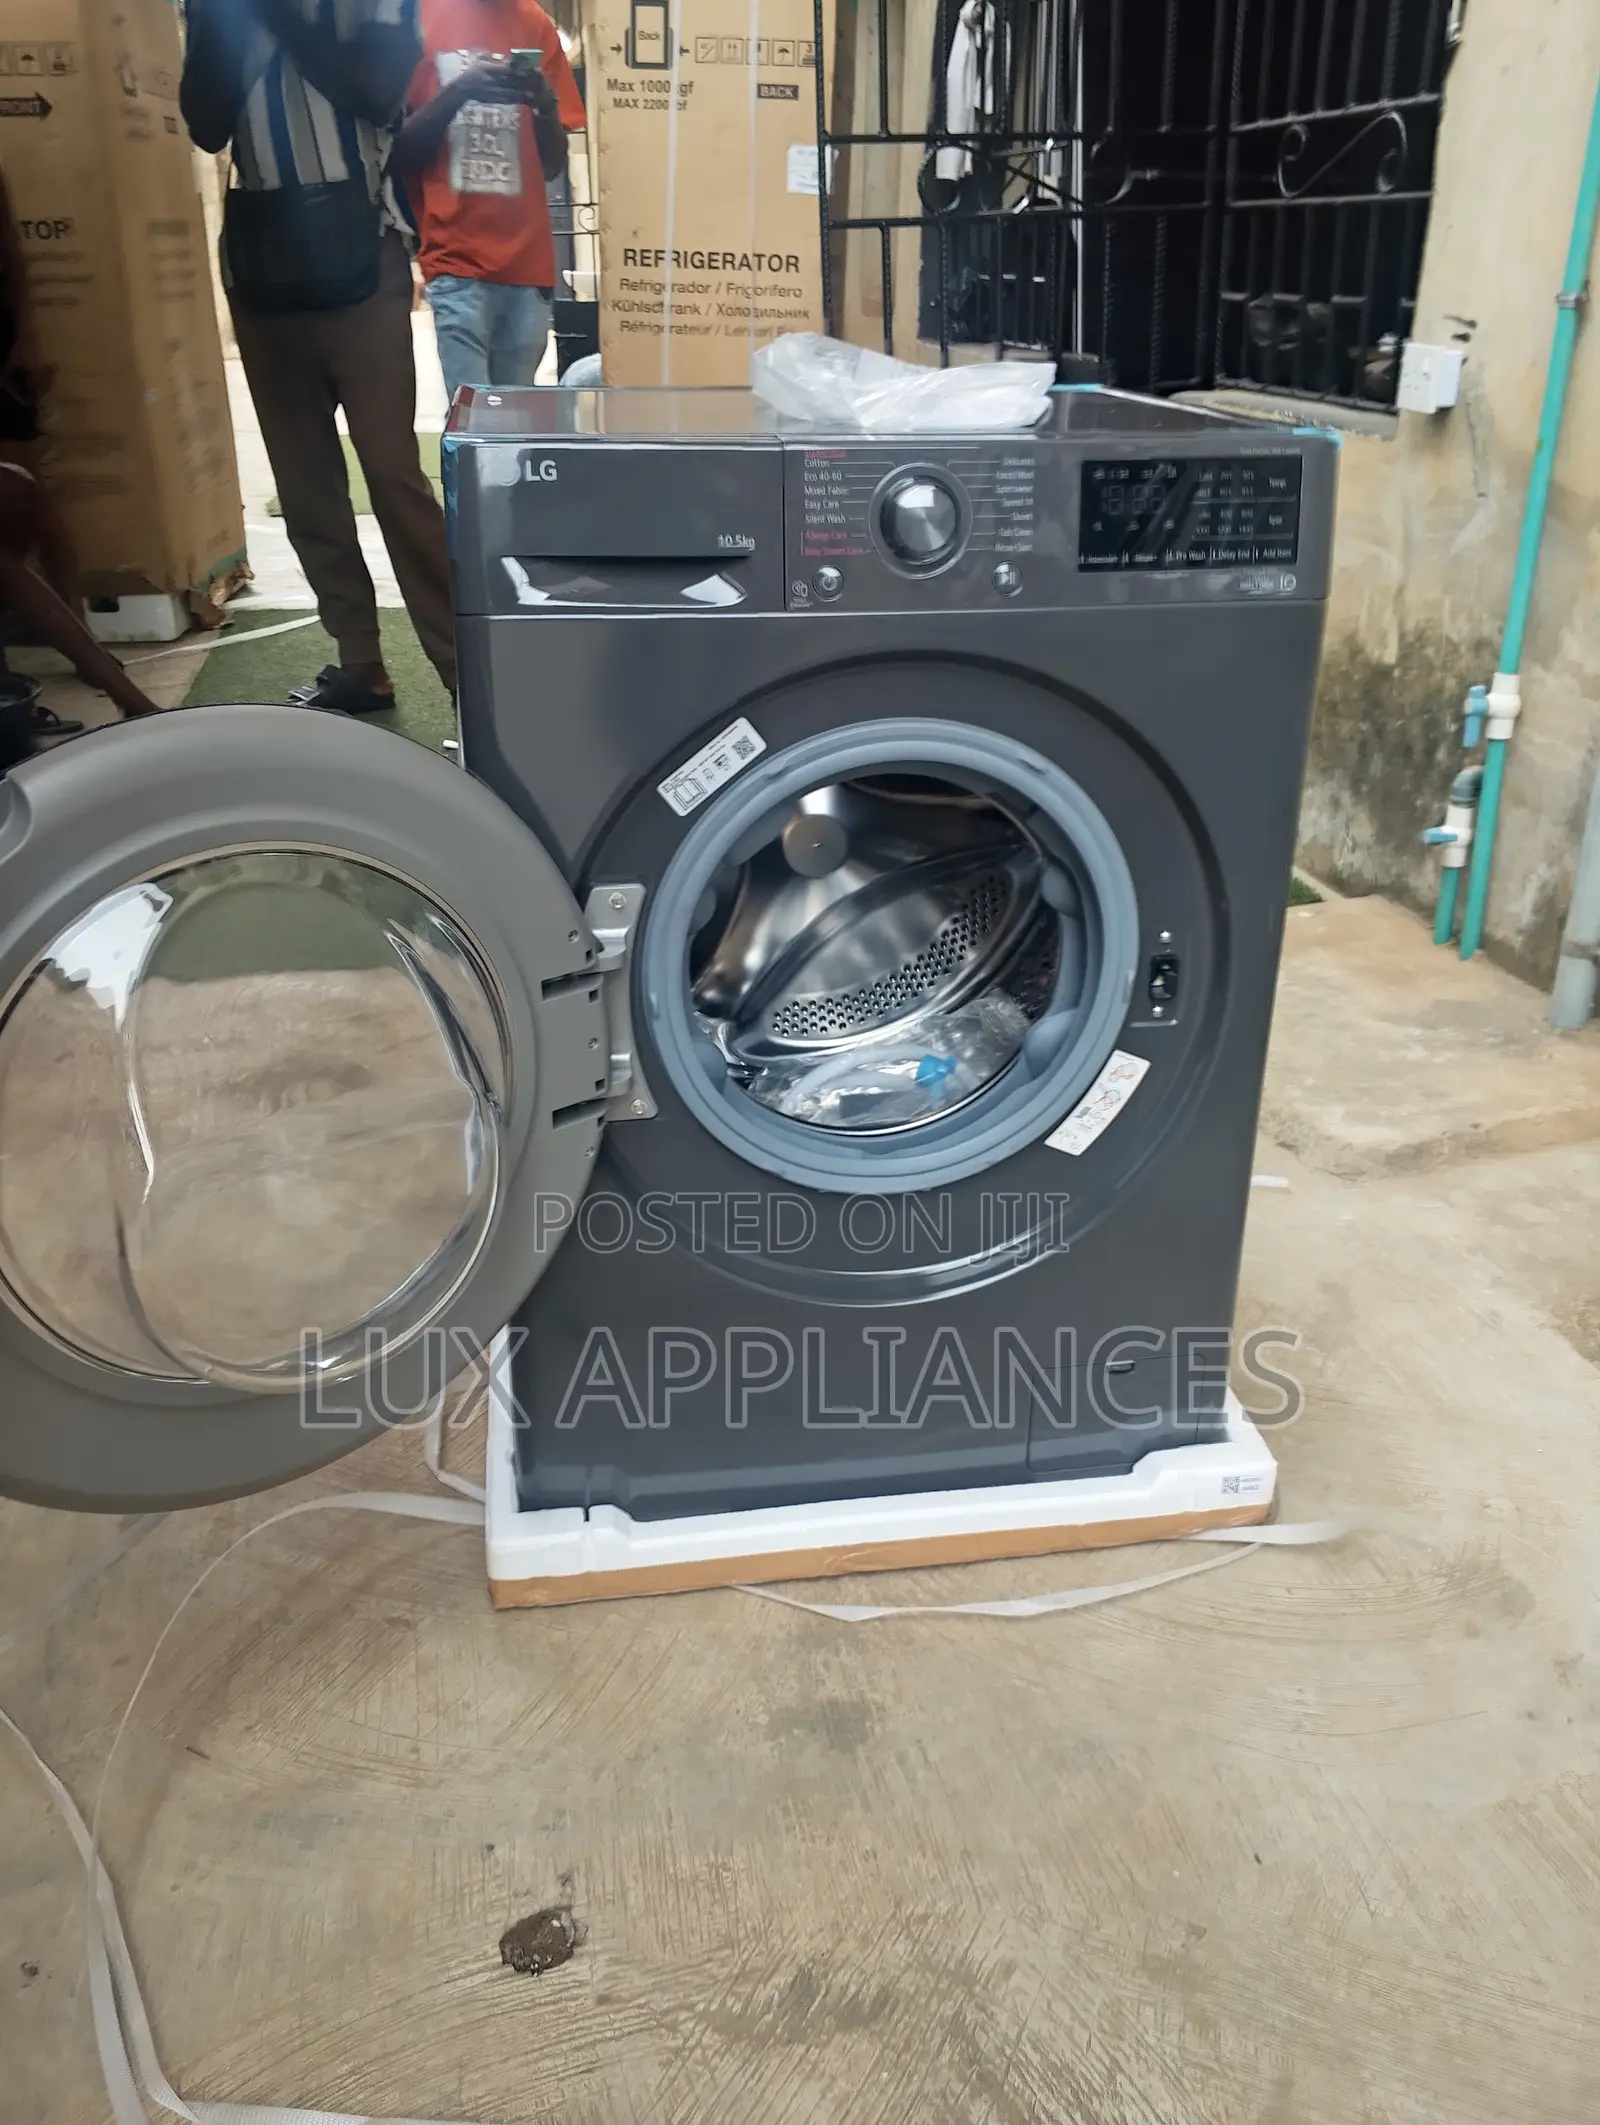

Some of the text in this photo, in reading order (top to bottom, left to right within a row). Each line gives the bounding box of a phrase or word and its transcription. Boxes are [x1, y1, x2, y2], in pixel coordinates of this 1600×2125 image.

[606, 78, 695, 97] Max 1000gf
[760, 86, 794, 98] BACK
[613, 97, 639, 109] MAX
[623, 248, 800, 273] REFRIGERATOR
[620, 278, 712, 295] Refrigrador
[804, 458, 830, 468] Cotton
[525, 459, 558, 482] LG
[804, 471, 818, 482] Eco
[804, 501, 821, 512] Easy
[717, 533, 756, 551] 10.5kg
